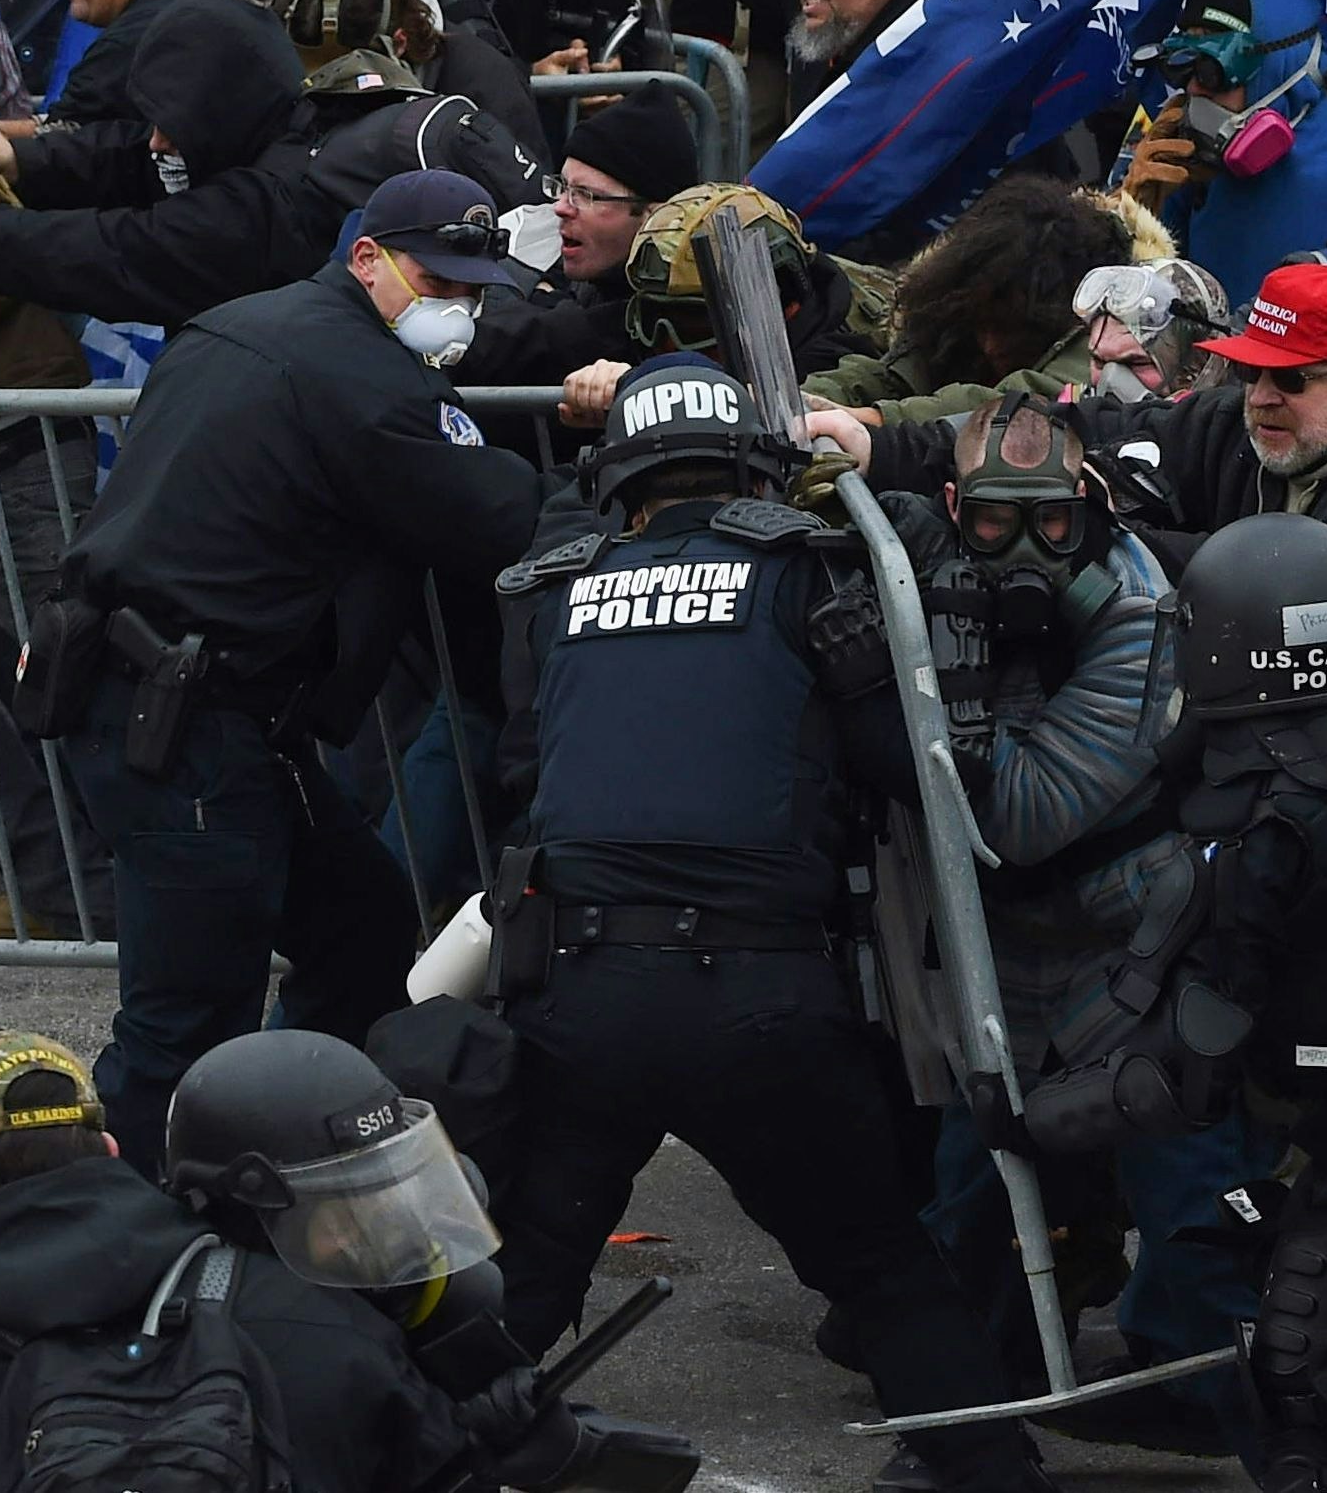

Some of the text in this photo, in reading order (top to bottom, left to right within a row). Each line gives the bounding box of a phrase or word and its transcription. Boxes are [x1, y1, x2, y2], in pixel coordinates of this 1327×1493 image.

[1255, 317, 1288, 338] AGAIN
[623, 380, 740, 438] MPDC
[568, 562, 751, 606] METROPOLITAN
[567, 591, 737, 636] POLICE
[1250, 649, 1300, 670] U.S.
[357, 1105, 394, 1136] S513
